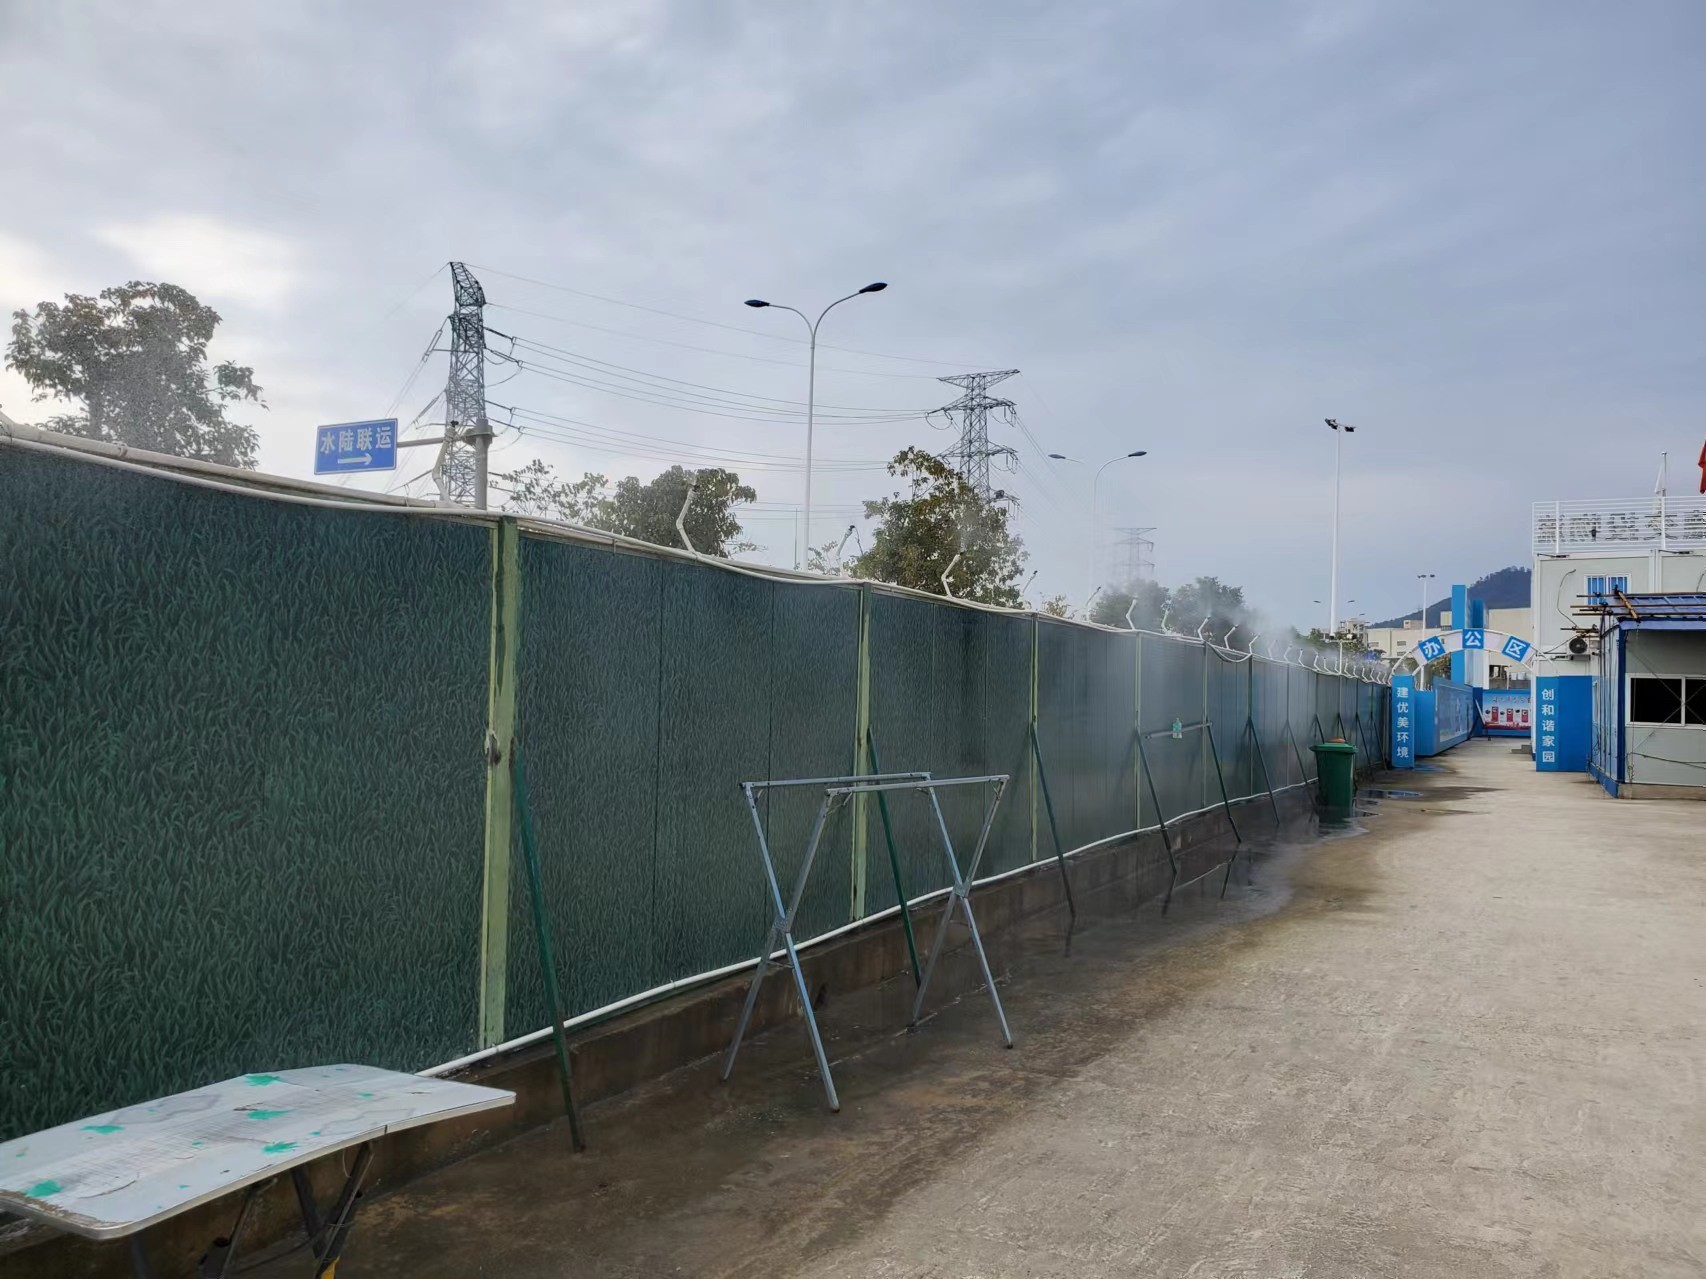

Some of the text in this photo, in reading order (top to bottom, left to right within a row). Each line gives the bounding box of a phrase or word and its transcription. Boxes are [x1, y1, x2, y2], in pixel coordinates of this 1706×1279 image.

[320, 427, 391, 454] 水陆联运
[1423, 631, 1526, 658] 办公区
[1396, 686, 1409, 758] 建优美环境
[1541, 688, 1555, 763] 创和谐家园
